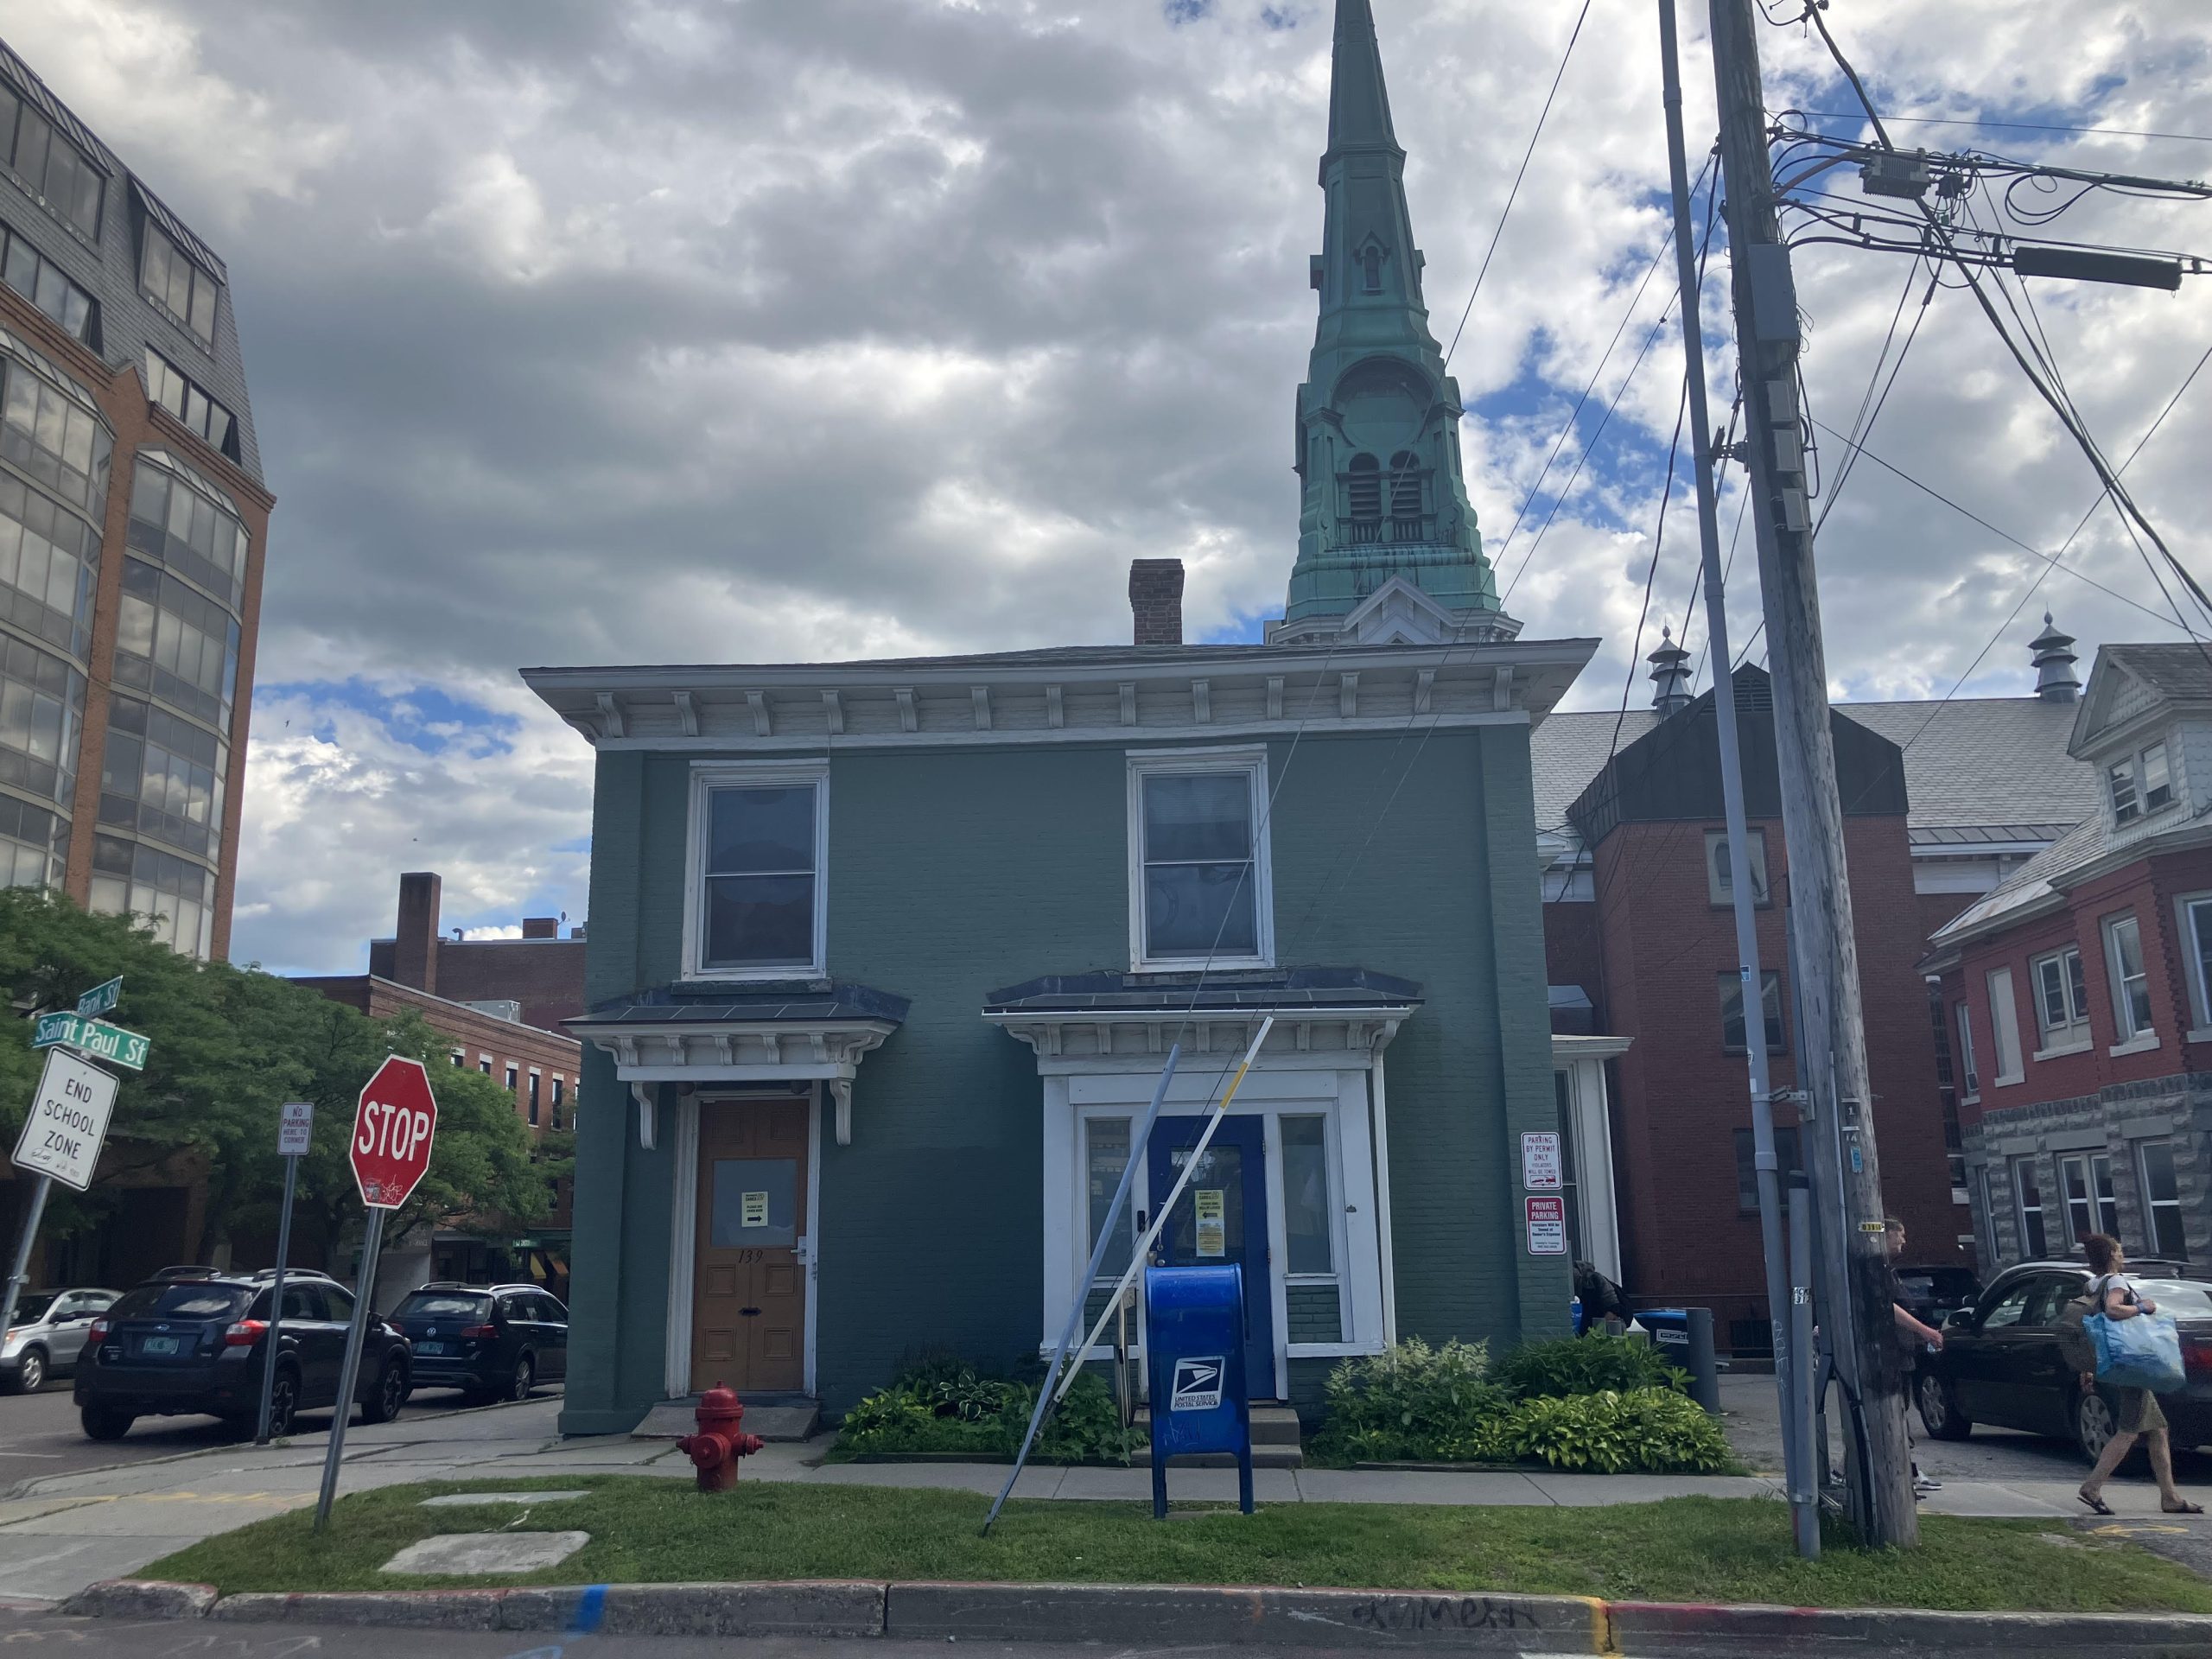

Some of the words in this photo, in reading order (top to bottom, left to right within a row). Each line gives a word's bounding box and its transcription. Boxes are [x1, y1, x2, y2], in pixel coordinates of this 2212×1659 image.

[78, 990, 103, 1015] Bank
[105, 983, 118, 1006] St
[35, 1018, 79, 1042] Saint
[80, 1022, 120, 1056] Paul
[125, 1039, 146, 1065] St
[65, 1077, 92, 1103] END
[44, 1099, 95, 1136] SCHOOL
[283, 1119, 309, 1128] PARKING
[293, 1107, 302, 1117] NO
[359, 1100, 429, 1161] STOP
[44, 1130, 82, 1160] ZONE
[1531, 1201, 1558, 1210] PRIVATE
[1531, 1211, 1559, 1220] PARKING
[739, 1249, 763, 1263] 139
